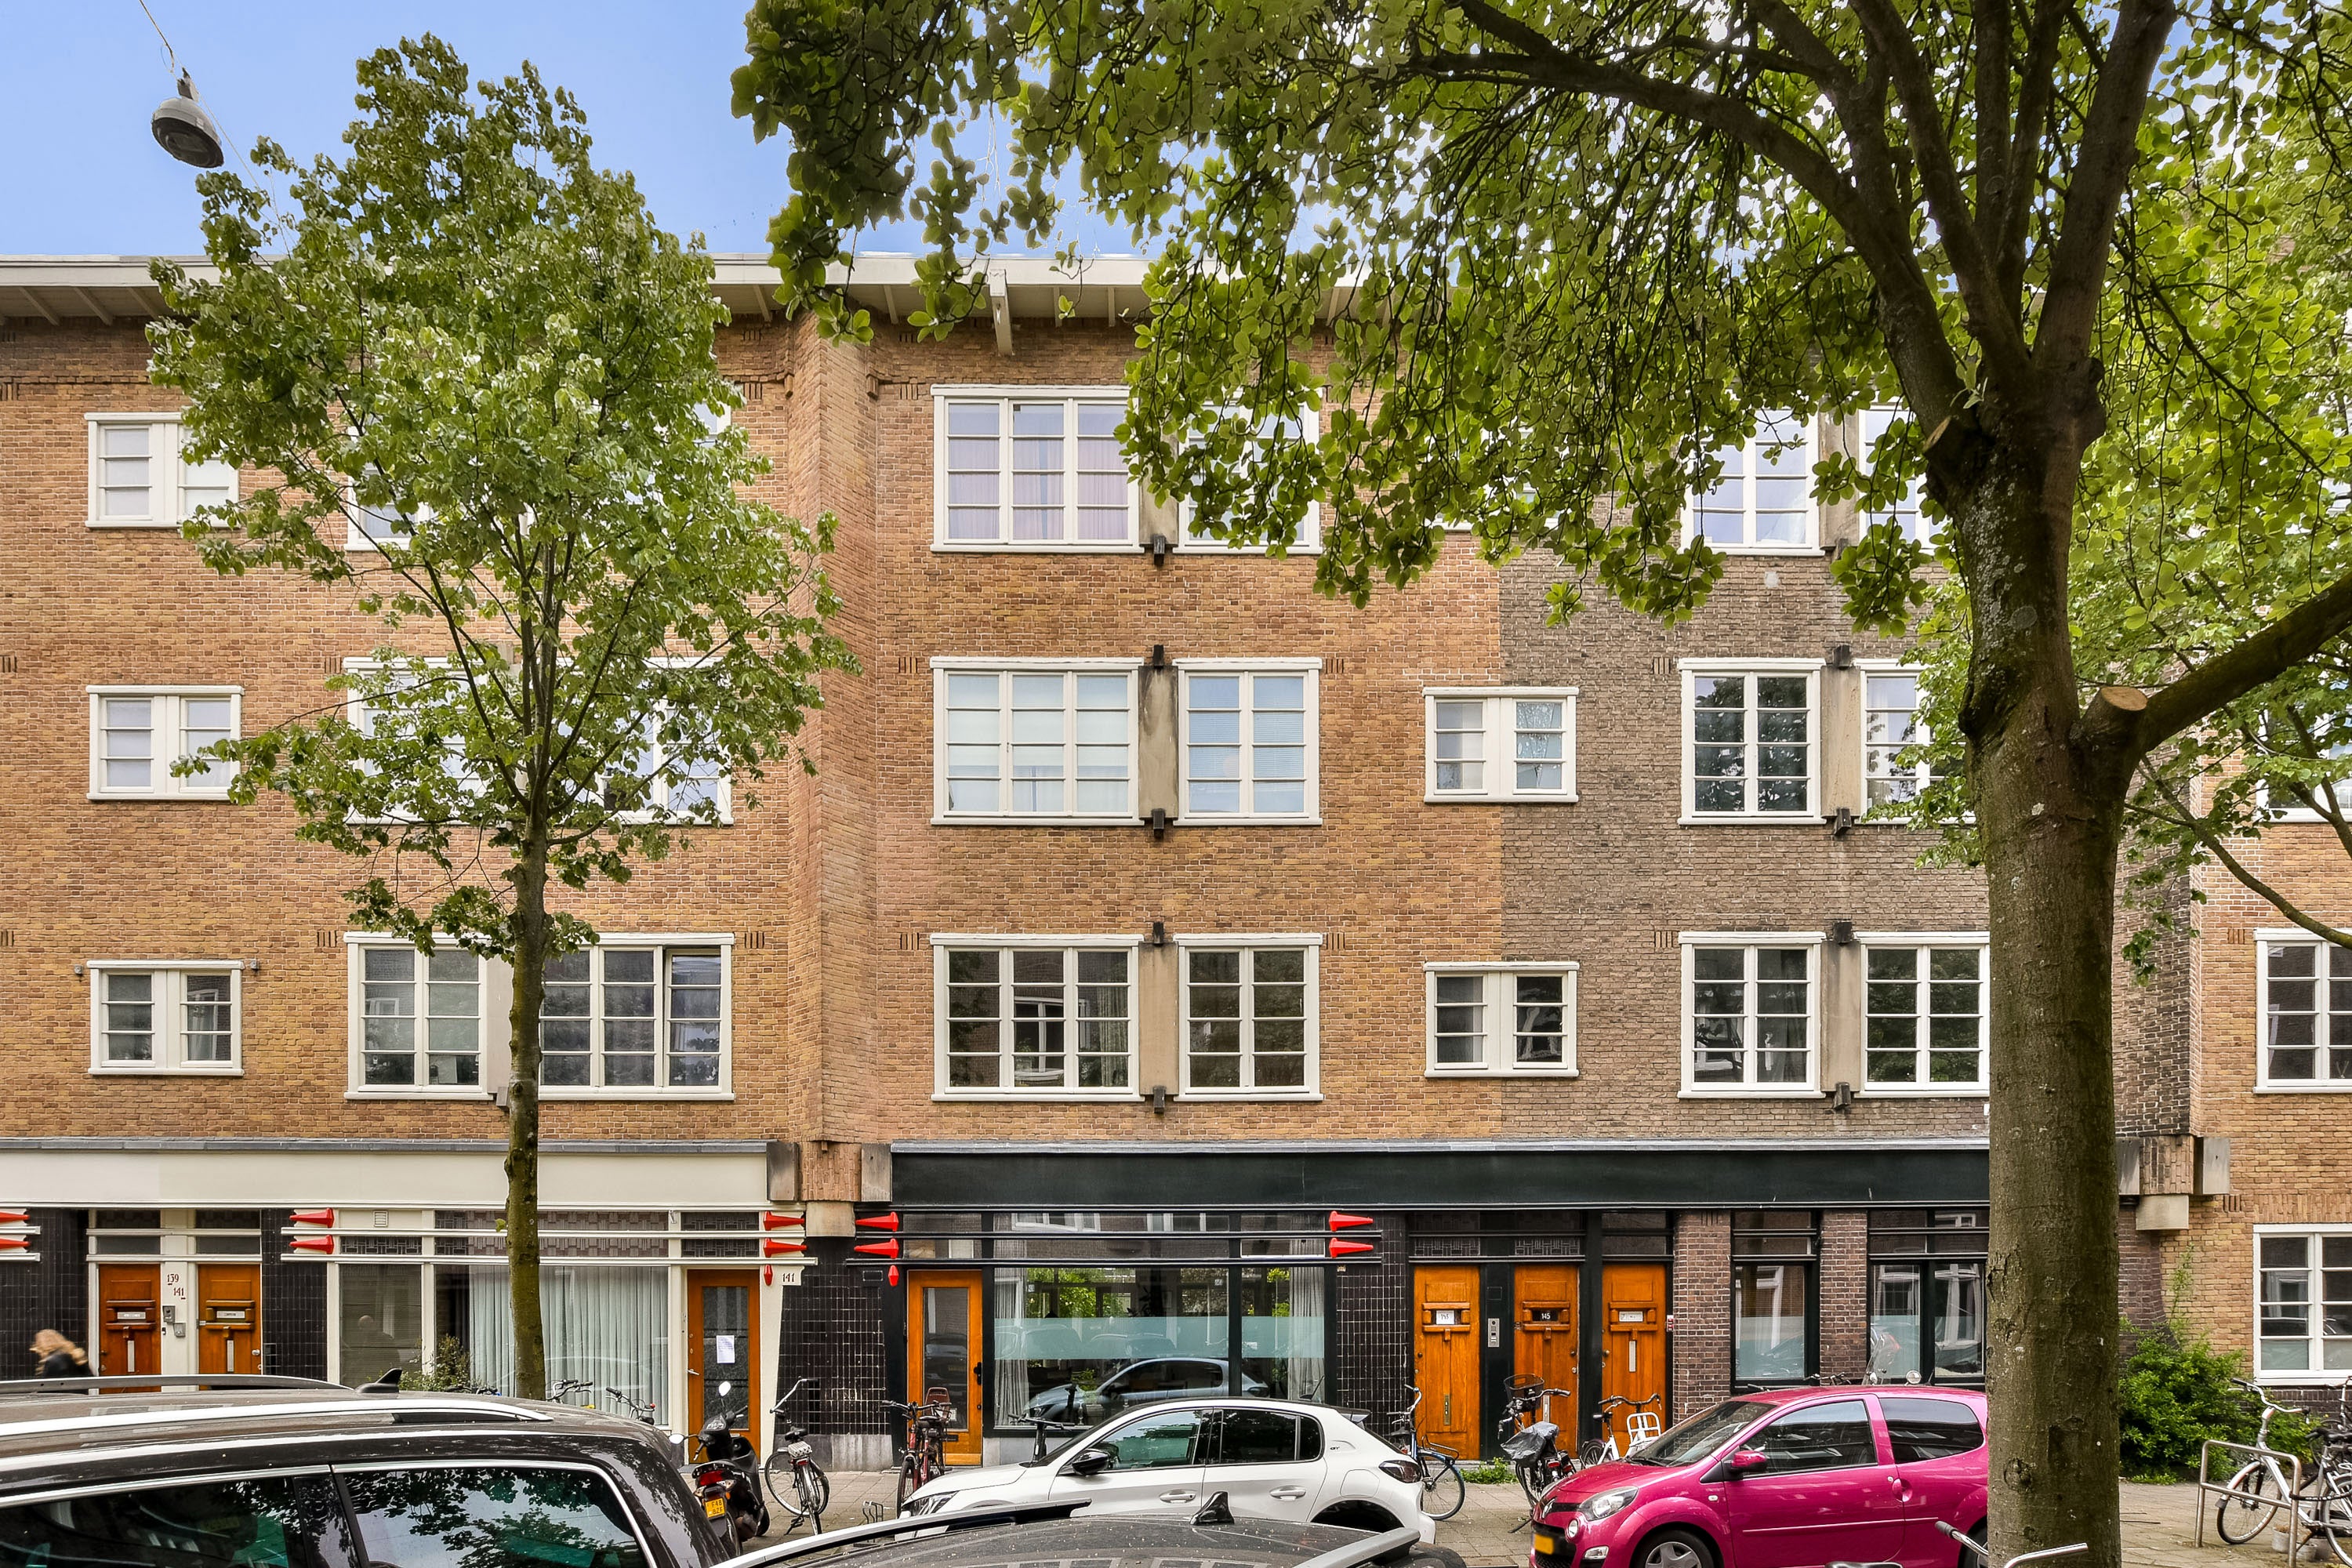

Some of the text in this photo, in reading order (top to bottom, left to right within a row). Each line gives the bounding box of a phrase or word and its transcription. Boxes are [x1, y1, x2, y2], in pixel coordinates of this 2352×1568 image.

[167, 1274, 179, 1283] 139
[782, 1273, 794, 1282] 141
[173, 1287, 184, 1296] 141
